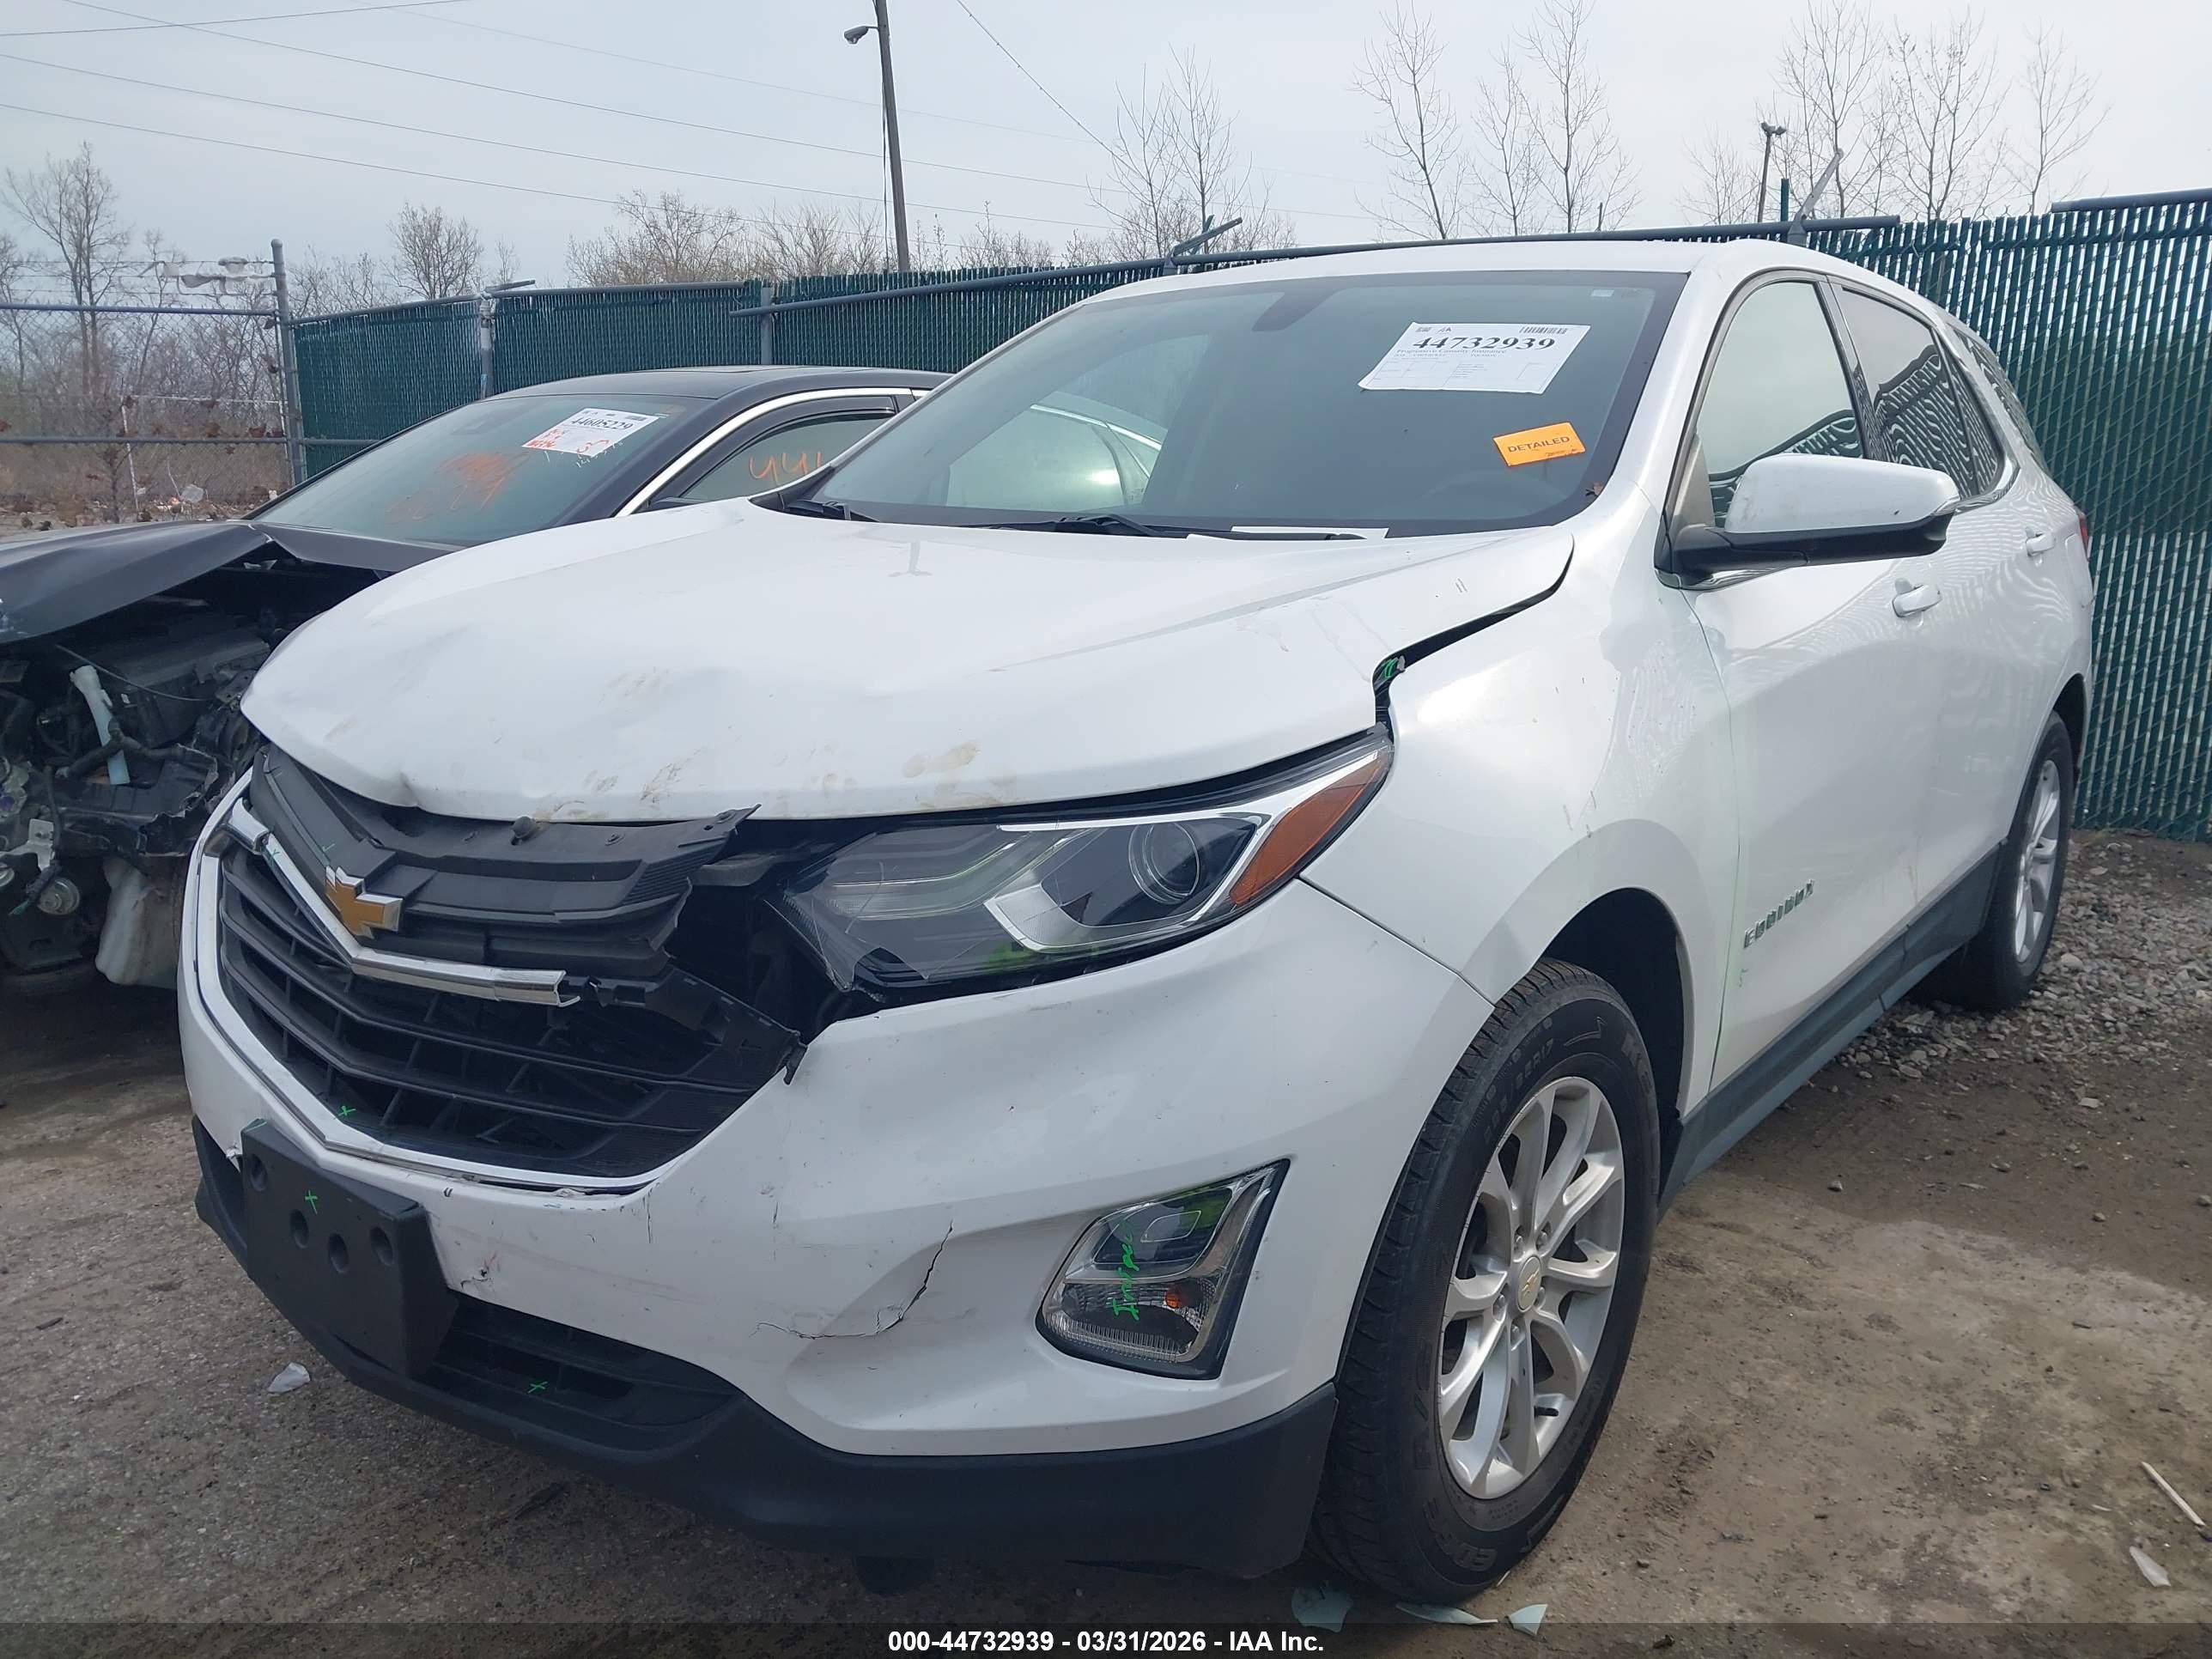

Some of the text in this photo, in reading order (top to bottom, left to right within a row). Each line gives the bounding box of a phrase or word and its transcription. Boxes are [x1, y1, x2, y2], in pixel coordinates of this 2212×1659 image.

[1413, 337, 1555, 350] 44732939
[1507, 436, 1571, 453] DETAILED
[1743, 878, 1814, 949] EQUINOX
